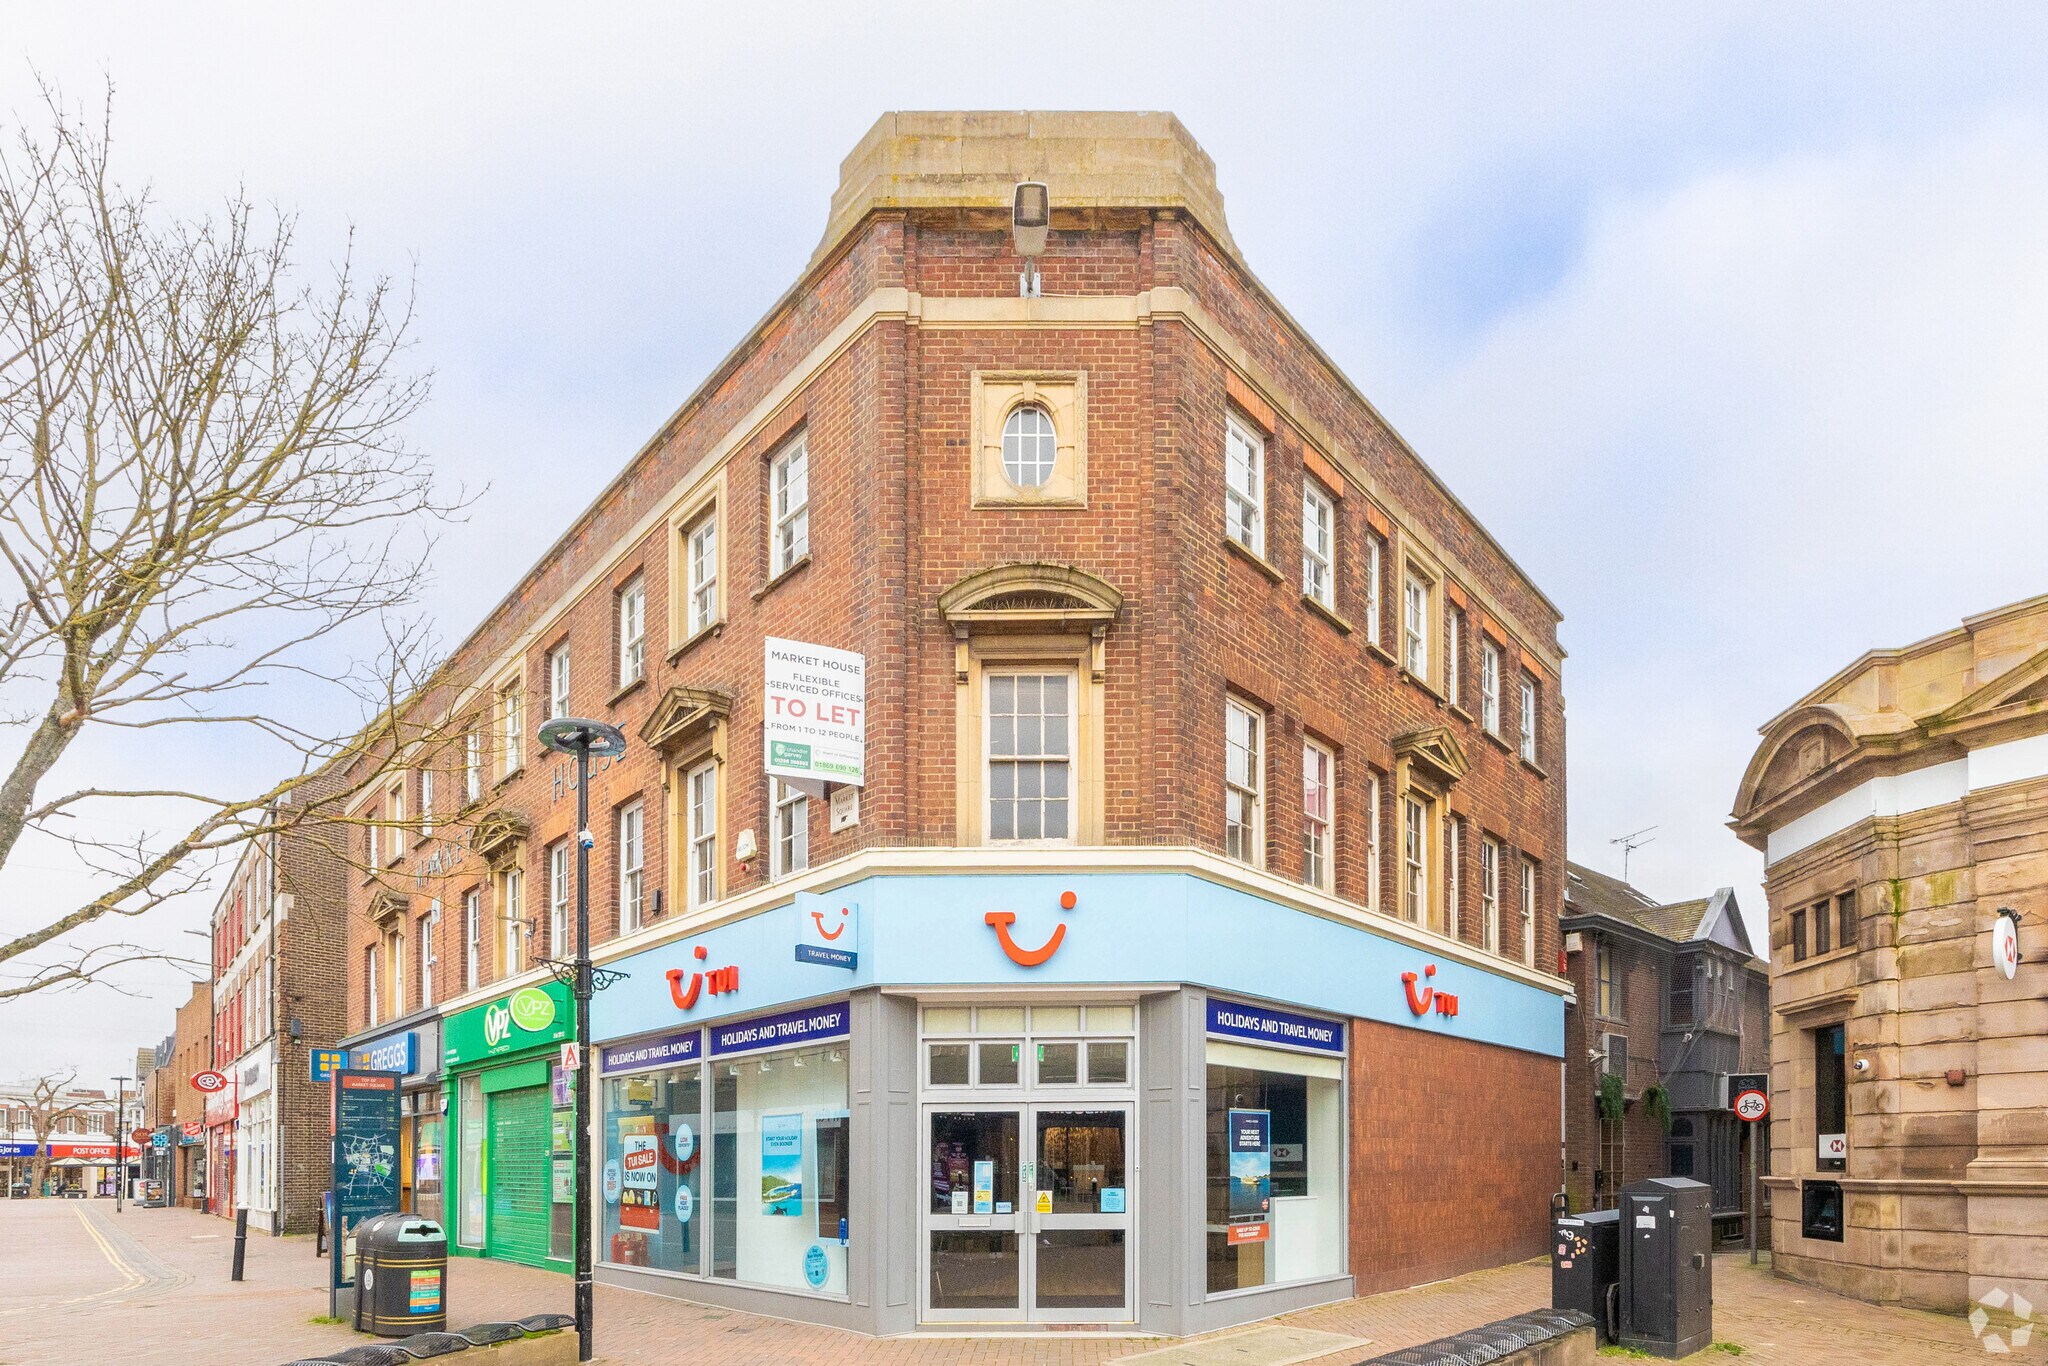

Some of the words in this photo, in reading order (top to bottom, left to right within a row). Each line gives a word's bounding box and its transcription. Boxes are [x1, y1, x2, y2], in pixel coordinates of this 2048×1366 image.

[771, 651, 819, 666] MARKET
[823, 660, 861, 675] HOUSE
[770, 680, 819, 695] SERVICED
[821, 689, 861, 703] OFFICES
[793, 673, 840, 688] FLEXIBLE
[771, 695, 807, 717] TO
[816, 703, 860, 727] LET
[771, 722, 796, 732] FROM
[807, 950, 830, 960] TRAVEL
[830, 953, 852, 962] MONEY
[705, 965, 739, 996] TUI
[517, 997, 551, 1016] VPZ
[486, 1006, 511, 1044] VPZ
[721, 1028, 758, 1046] HOLIDAYS
[758, 1024, 776, 1040] AND
[777, 1019, 808, 1037] TRAVEL
[808, 1013, 841, 1032] MONEY
[1217, 1011, 1260, 1031] HOLIDAYS
[1261, 1019, 1278, 1034] AND
[1279, 1022, 1307, 1039] TRAVEL
[1307, 1026, 1333, 1043] MONEY
[370, 1041, 406, 1070] GREGGS
[608, 1051, 635, 1066] HOLIDAYS
[635, 1049, 648, 1061] AND
[648, 1045, 670, 1059] TRAVEL
[670, 1040, 694, 1055] MONEY
[72, 1147, 89, 1155] POST
[89, 1147, 110, 1155] OFFICE
[635, 1141, 646, 1151] THE
[627, 1156, 638, 1167] TUI
[638, 1152, 653, 1165] SALE
[624, 1172, 630, 1181] IS
[631, 1172, 645, 1182] NOW
[647, 1173, 656, 1183] ON
